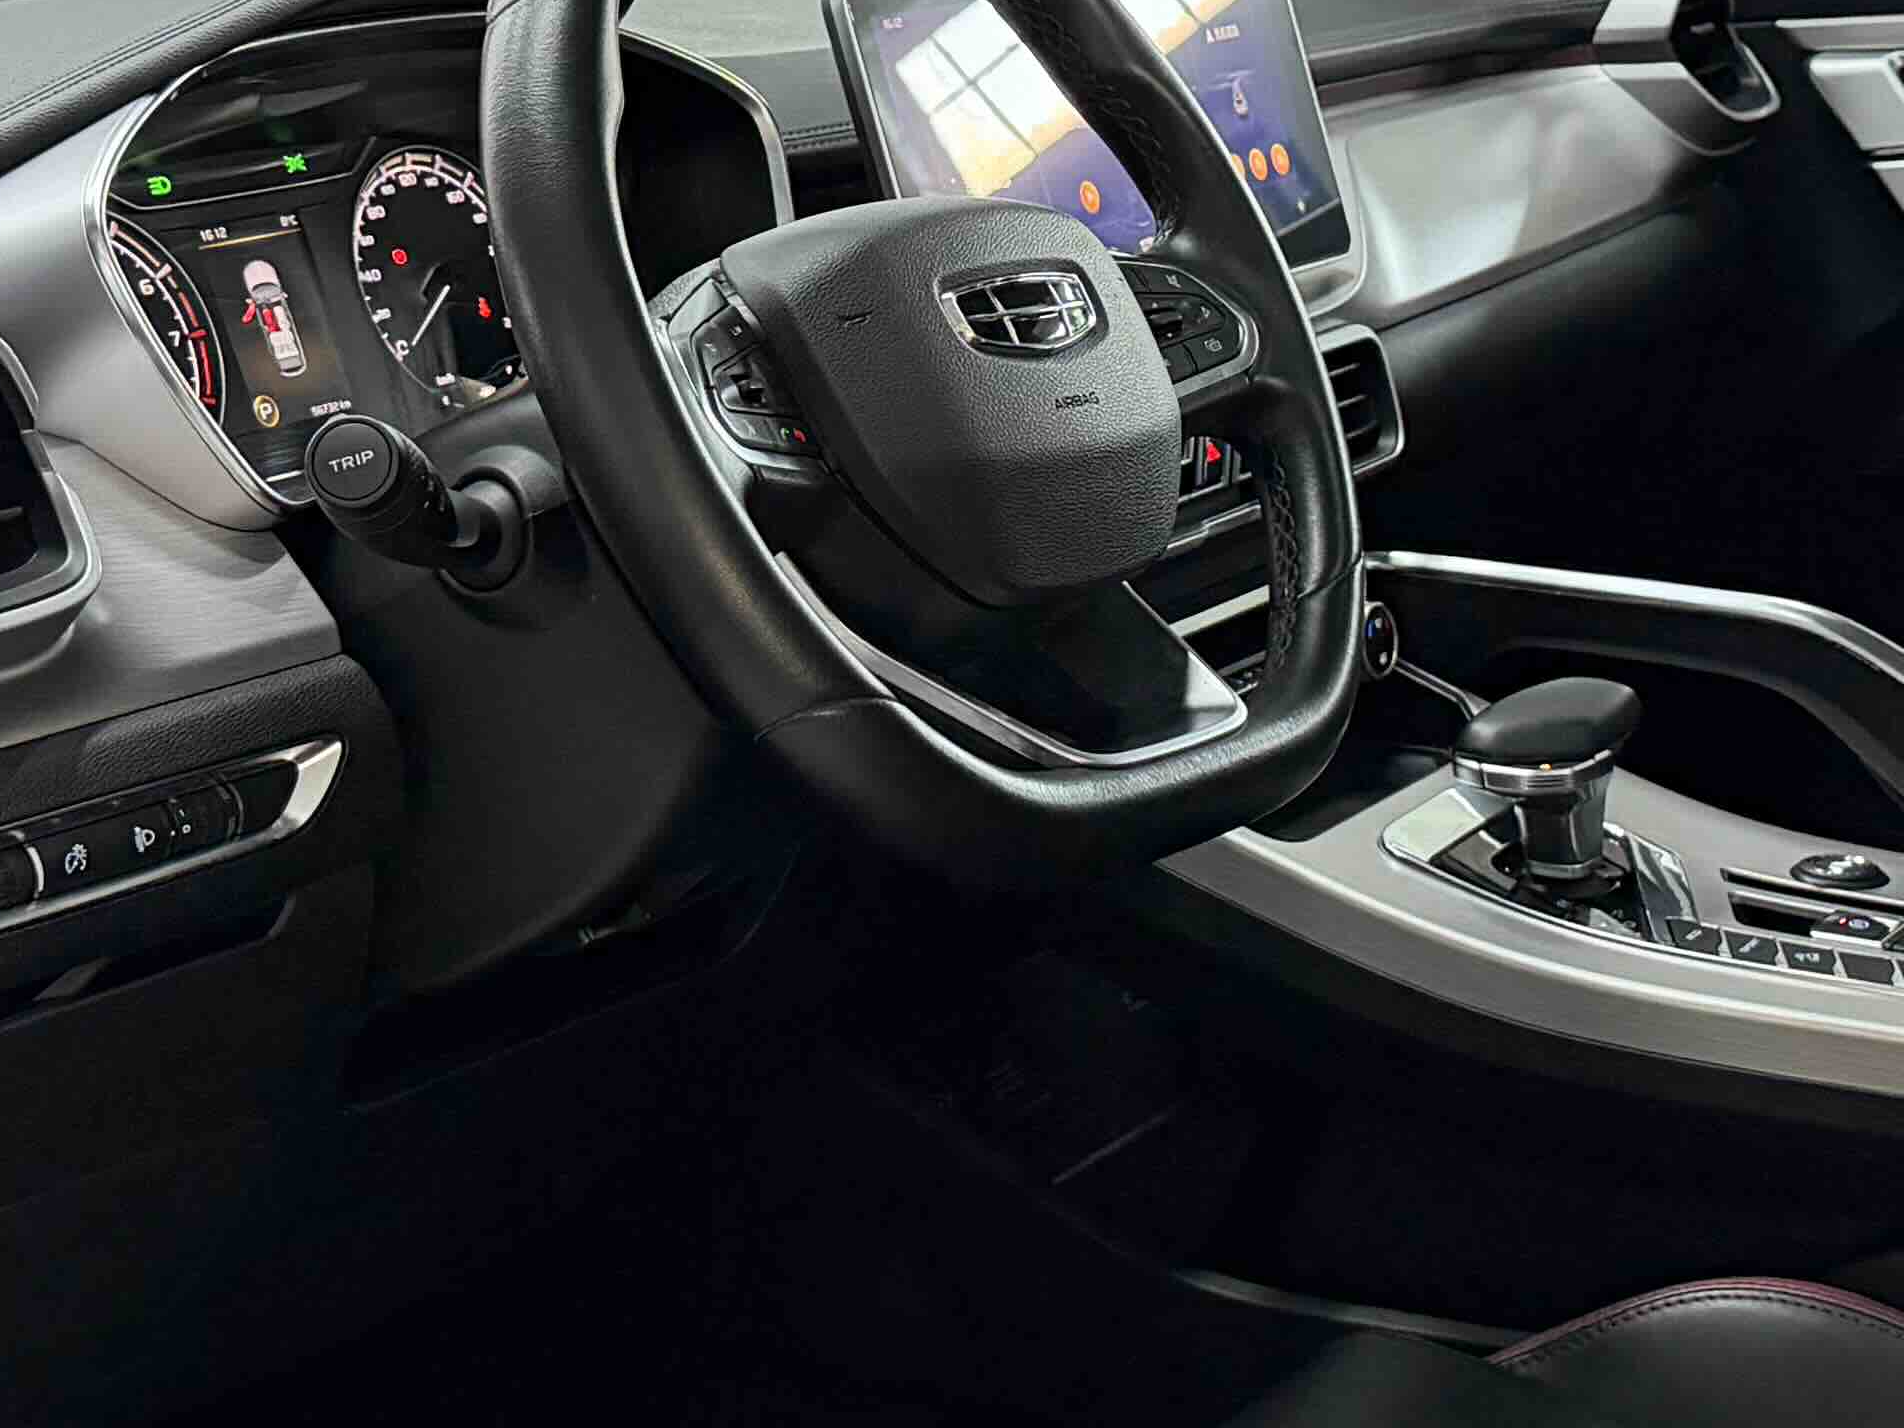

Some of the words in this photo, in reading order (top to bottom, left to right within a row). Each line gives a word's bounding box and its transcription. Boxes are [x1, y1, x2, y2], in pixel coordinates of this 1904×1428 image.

[138, 278, 155, 295] 6
[168, 330, 180, 347] 7
[1055, 391, 1100, 409] AIRBAG
[328, 450, 375, 473] TRIP
